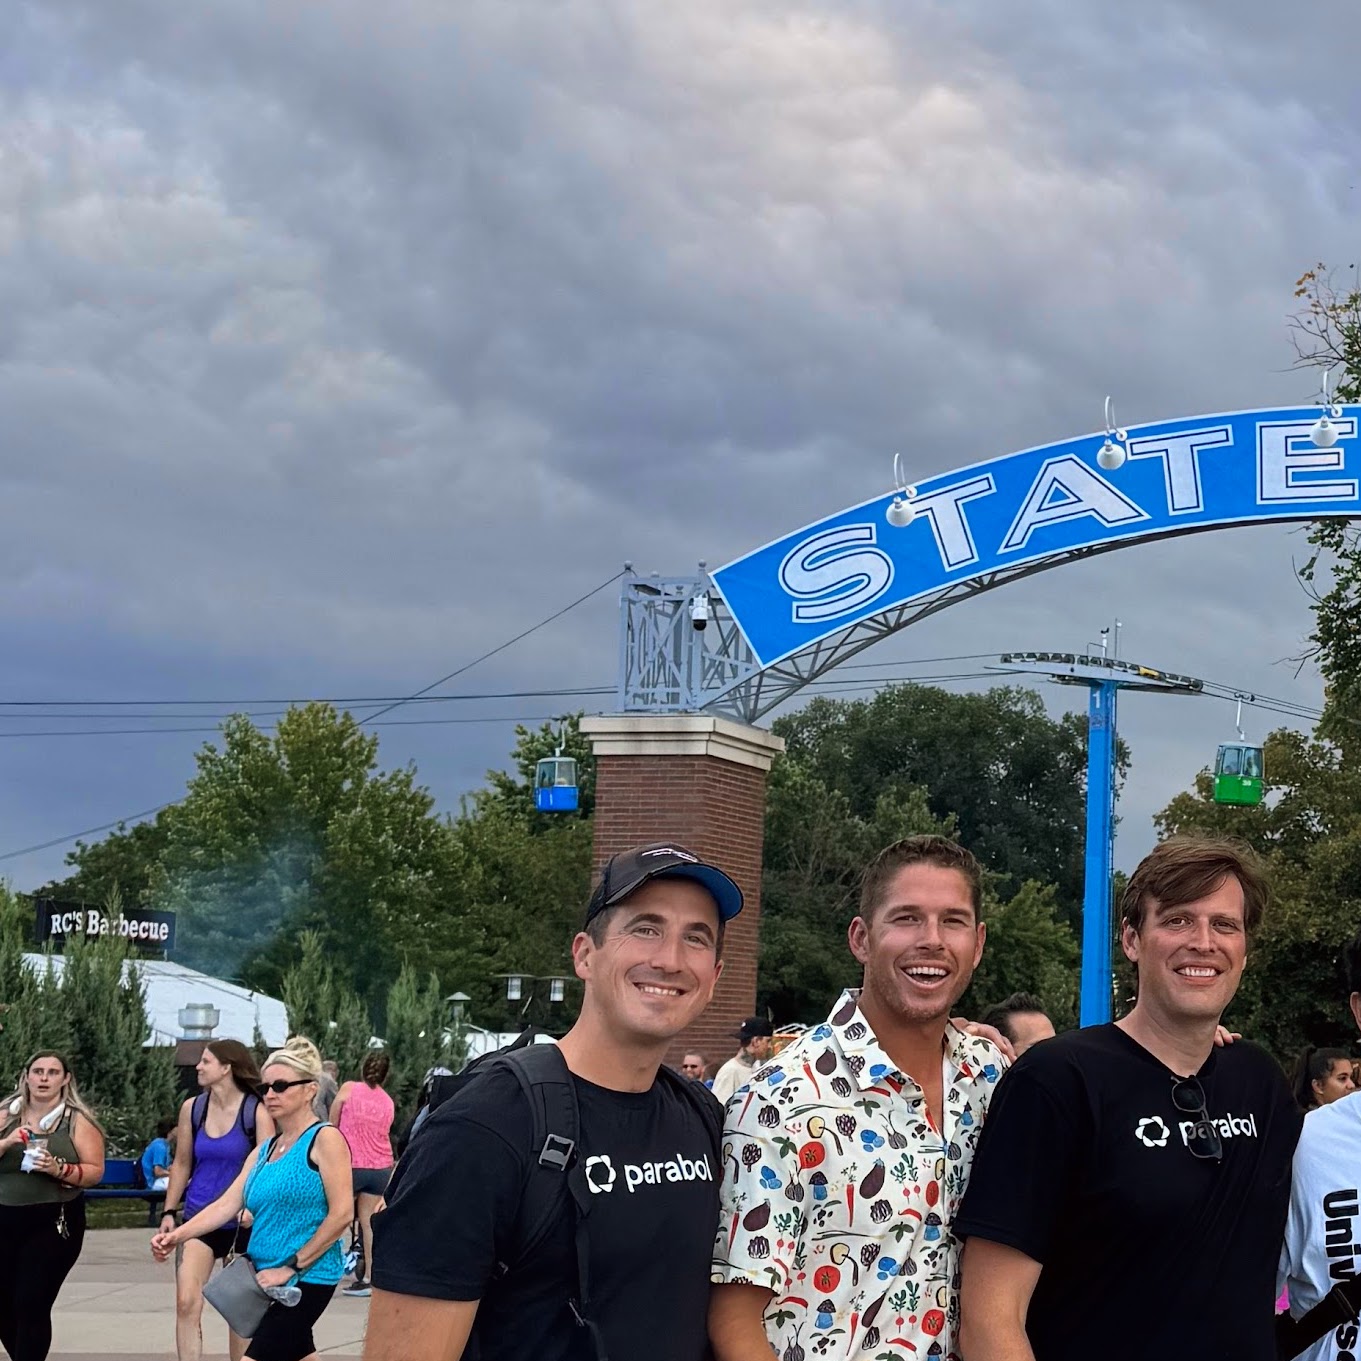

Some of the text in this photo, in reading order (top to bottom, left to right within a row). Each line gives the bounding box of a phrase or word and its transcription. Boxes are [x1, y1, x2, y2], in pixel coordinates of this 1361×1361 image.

[778, 416, 1359, 624] STATE
[86, 909, 170, 940] Barbecue
[1178, 1112, 1258, 1147] parabol
[624, 1153, 713, 1193] parabol
